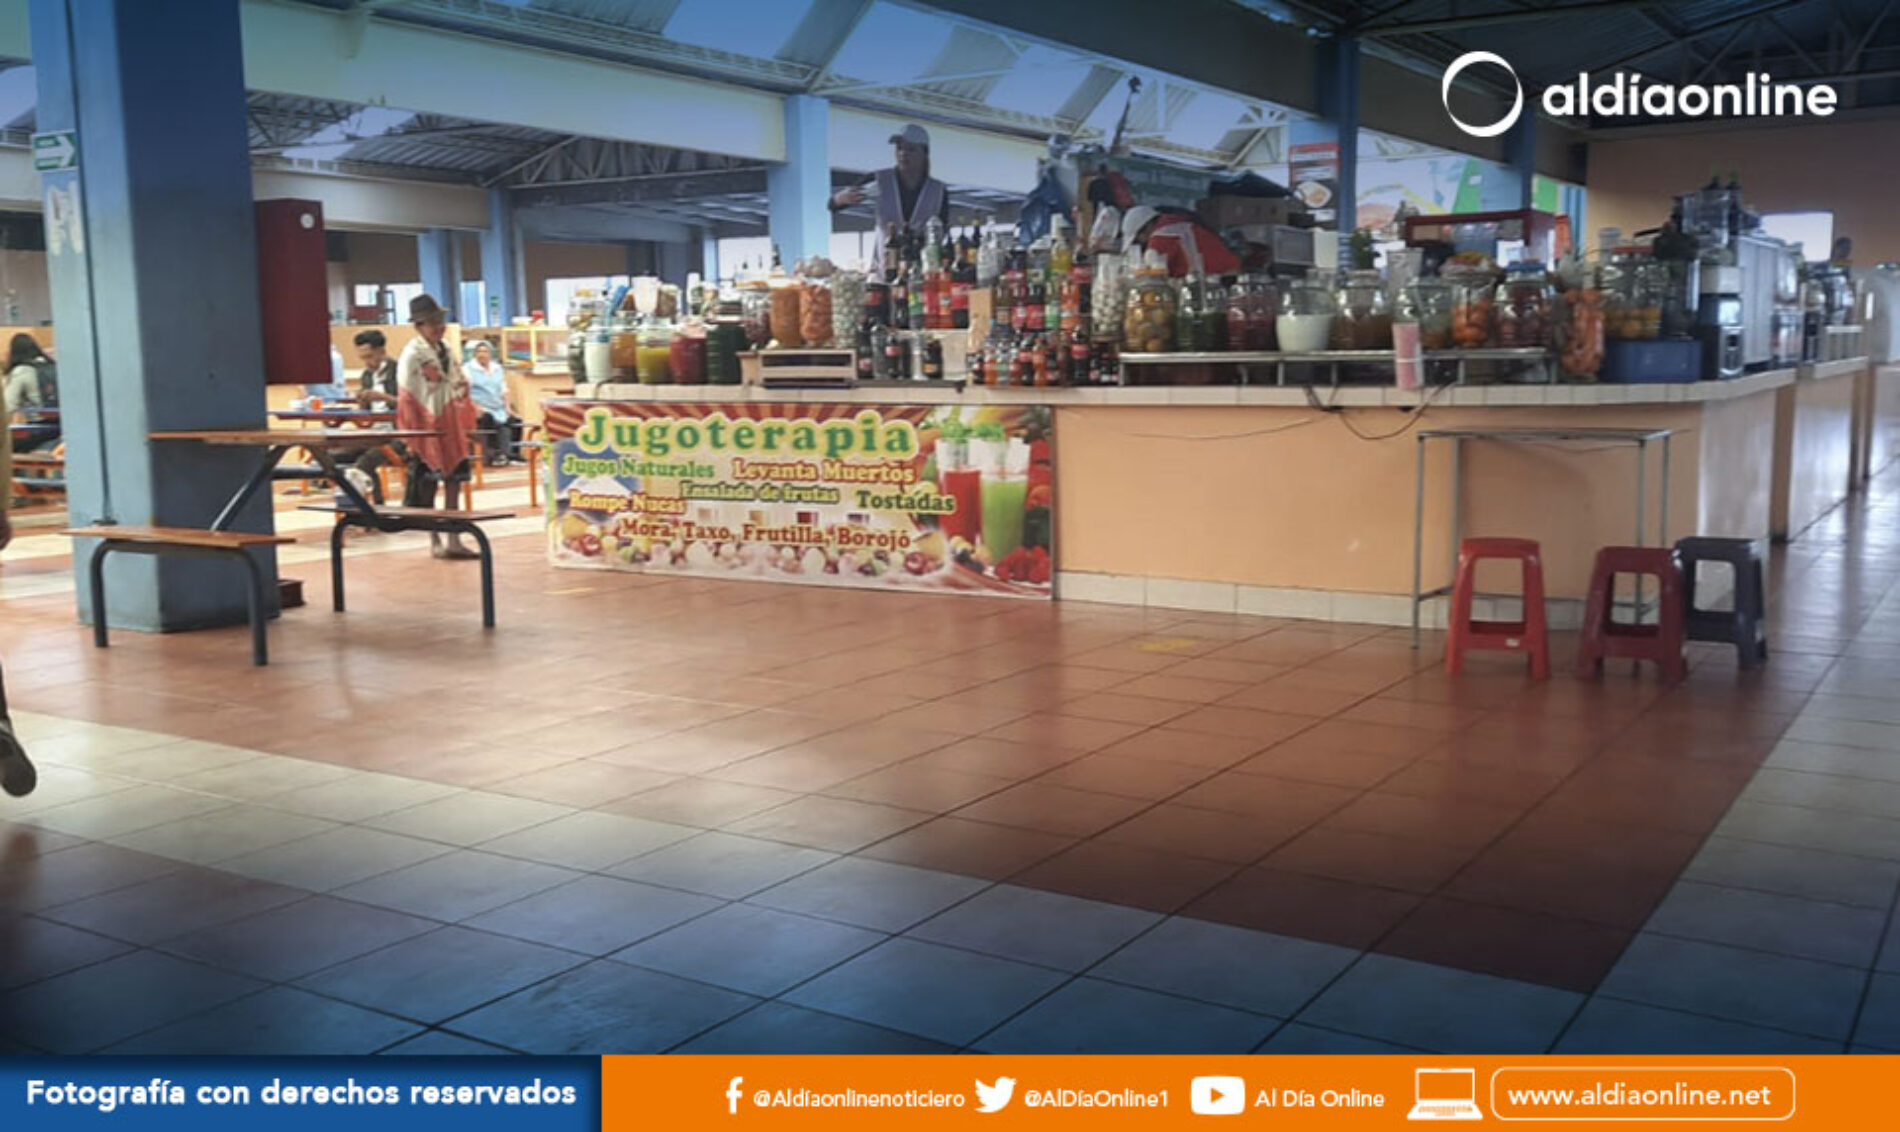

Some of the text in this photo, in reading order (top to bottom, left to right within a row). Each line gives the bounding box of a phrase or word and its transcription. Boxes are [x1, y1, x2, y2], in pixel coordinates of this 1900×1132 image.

[581, 414, 910, 457] Jugoterapia
[563, 455, 714, 478] Jugos Naturales
[732, 458, 916, 484] Levanta Muertos
[759, 484, 779, 501] de
[784, 484, 839, 503] frutas
[856, 491, 955, 511] Tostadas
[621, 519, 911, 550] Mora, Taxo, Frutilla, Borojó
